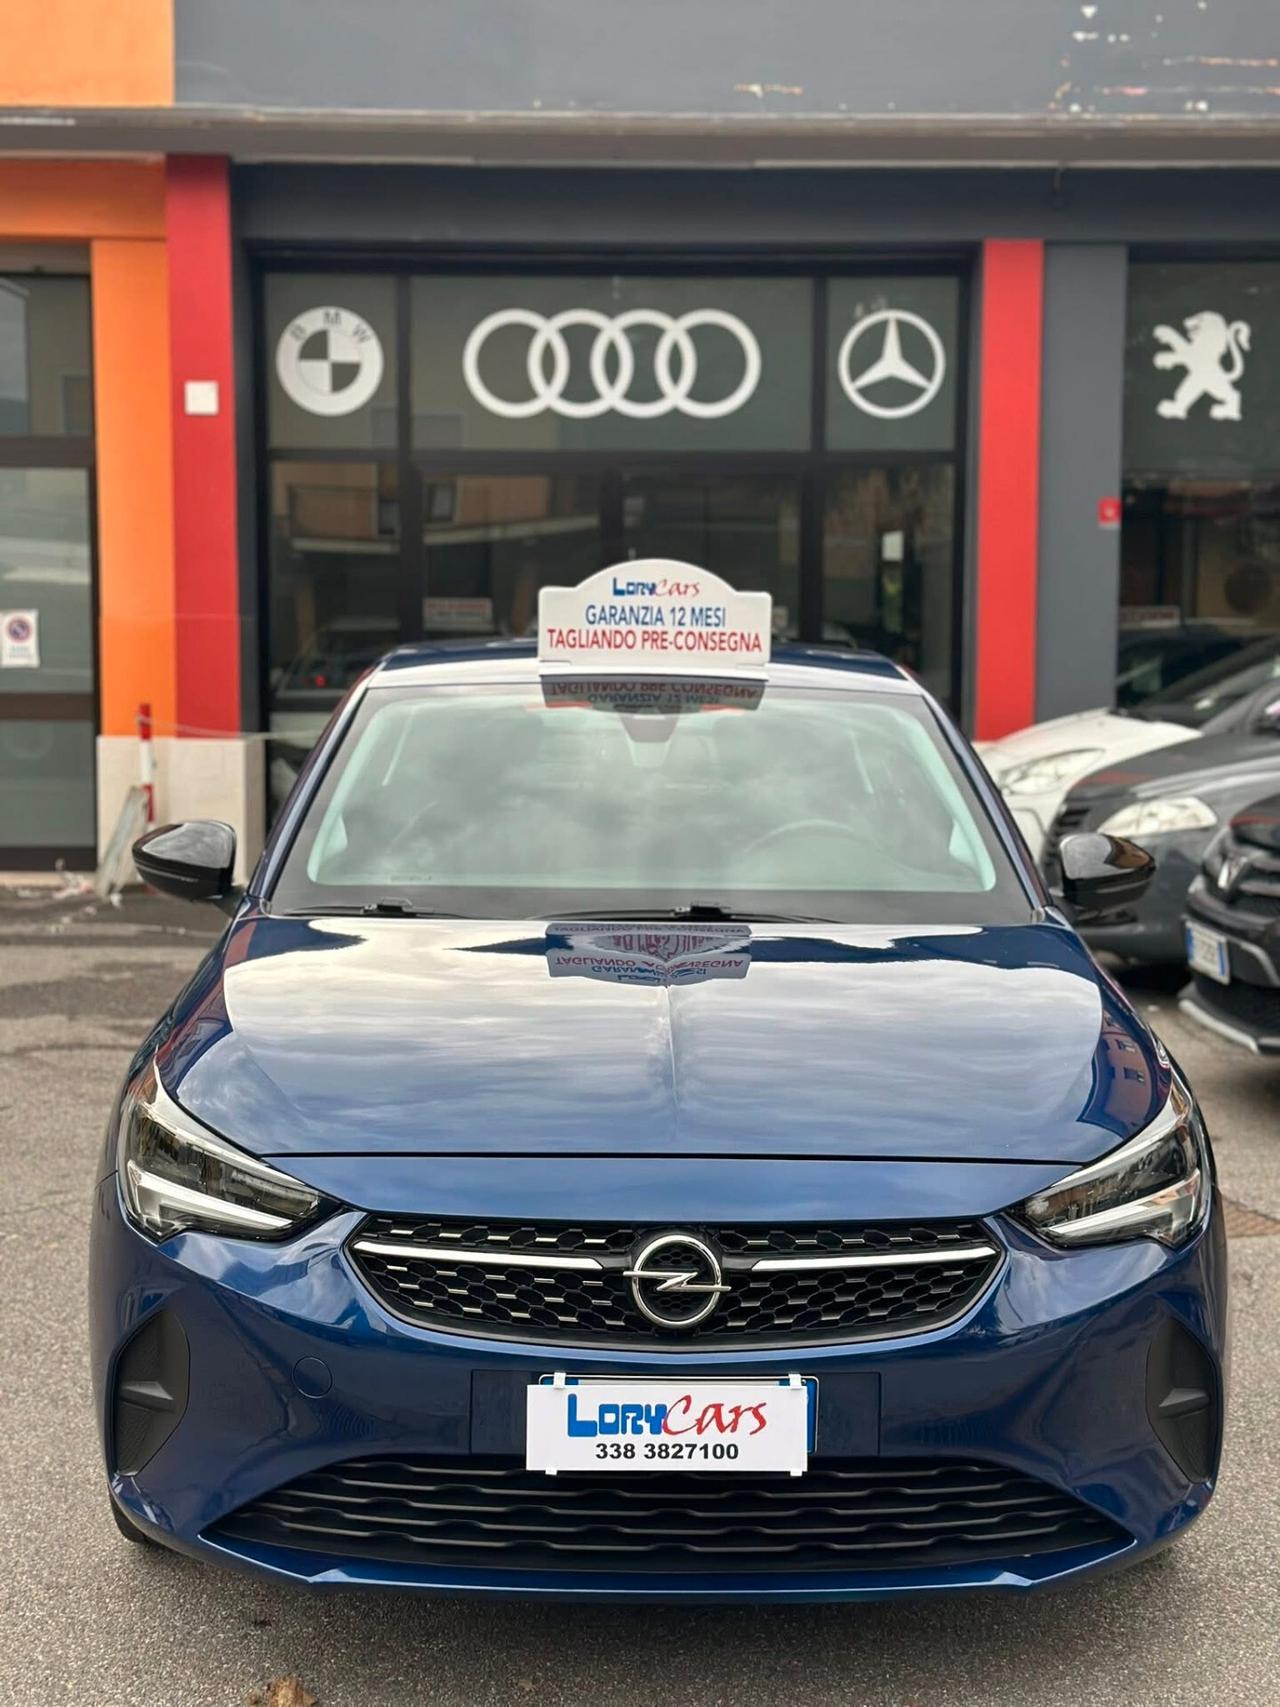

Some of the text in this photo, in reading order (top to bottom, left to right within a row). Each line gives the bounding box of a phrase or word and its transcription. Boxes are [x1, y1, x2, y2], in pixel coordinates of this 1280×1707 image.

[585, 604, 726, 628] GARANZIA 12 MESI
[547, 628, 763, 653] TAGLIANDO PRE-CONSEGNA
[595, 1443, 739, 1460] 338 3827100
